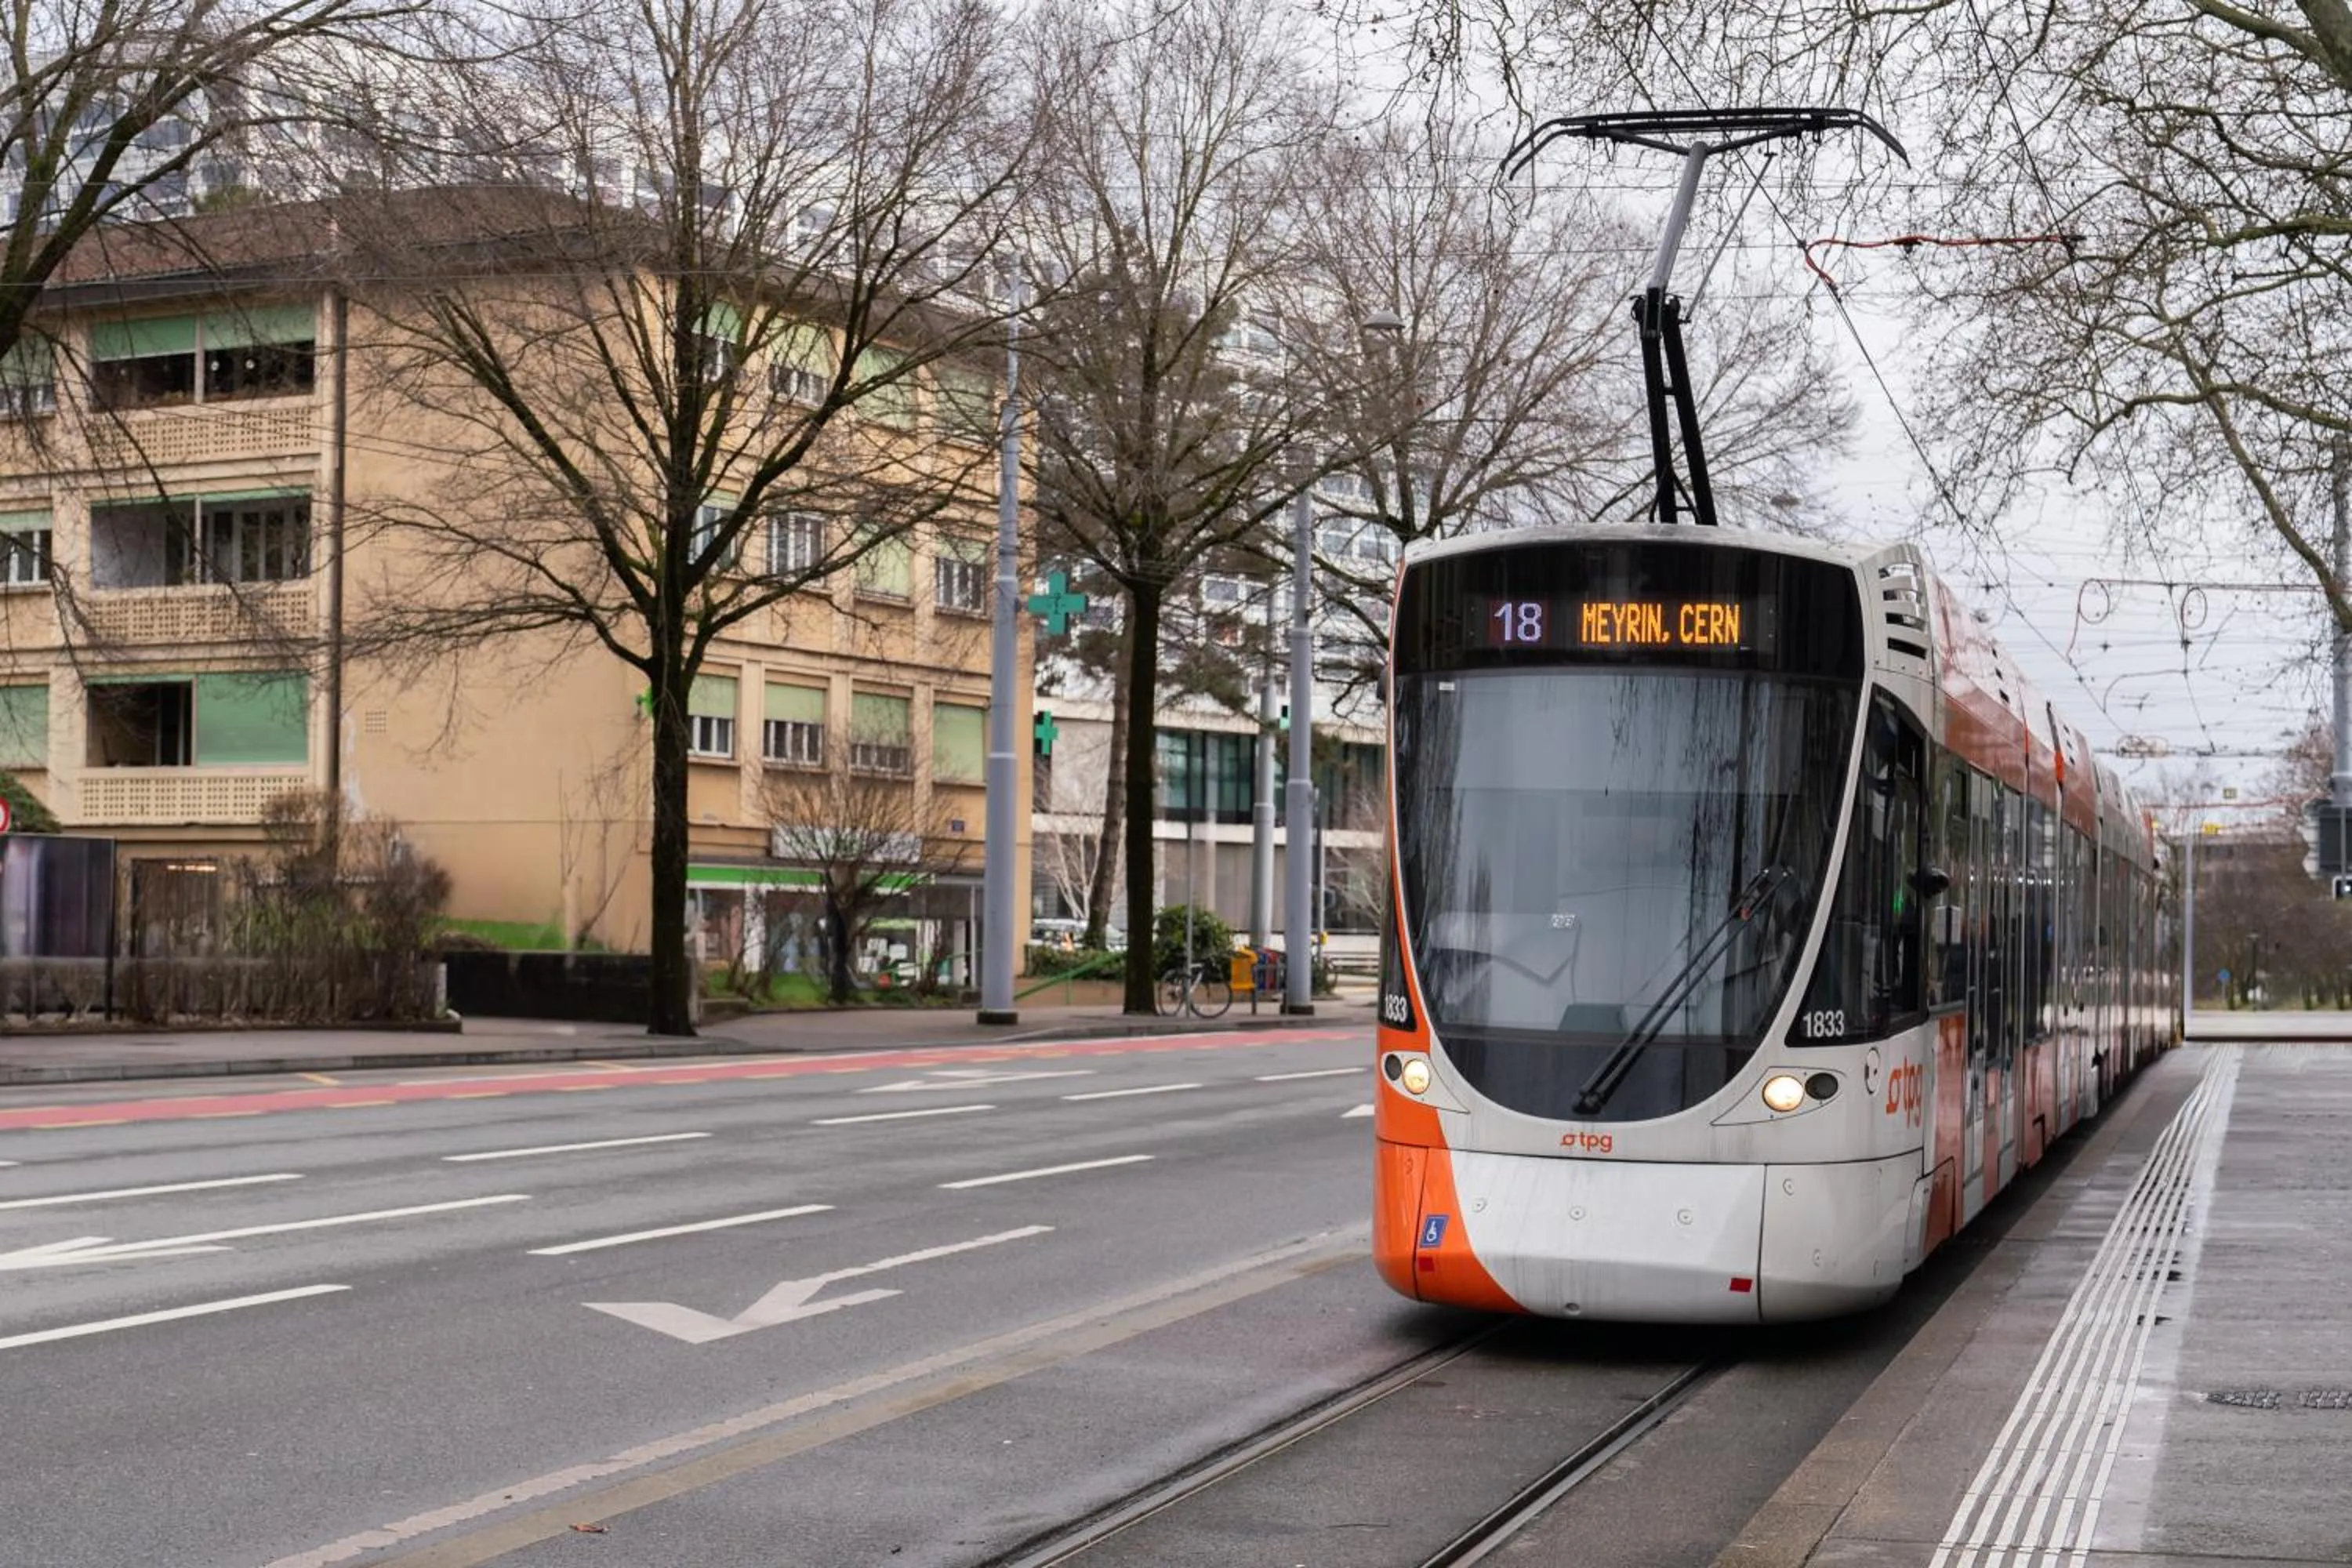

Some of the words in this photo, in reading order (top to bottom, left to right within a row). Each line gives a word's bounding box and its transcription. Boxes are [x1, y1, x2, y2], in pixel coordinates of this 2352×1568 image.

[1494, 602, 1542, 641] 18
[1581, 602, 1671, 643] MEYRIN,
[1679, 603, 1740, 644] CERN
[1385, 992, 1407, 1022] 1833
[1802, 1009, 1845, 1038] 1833
